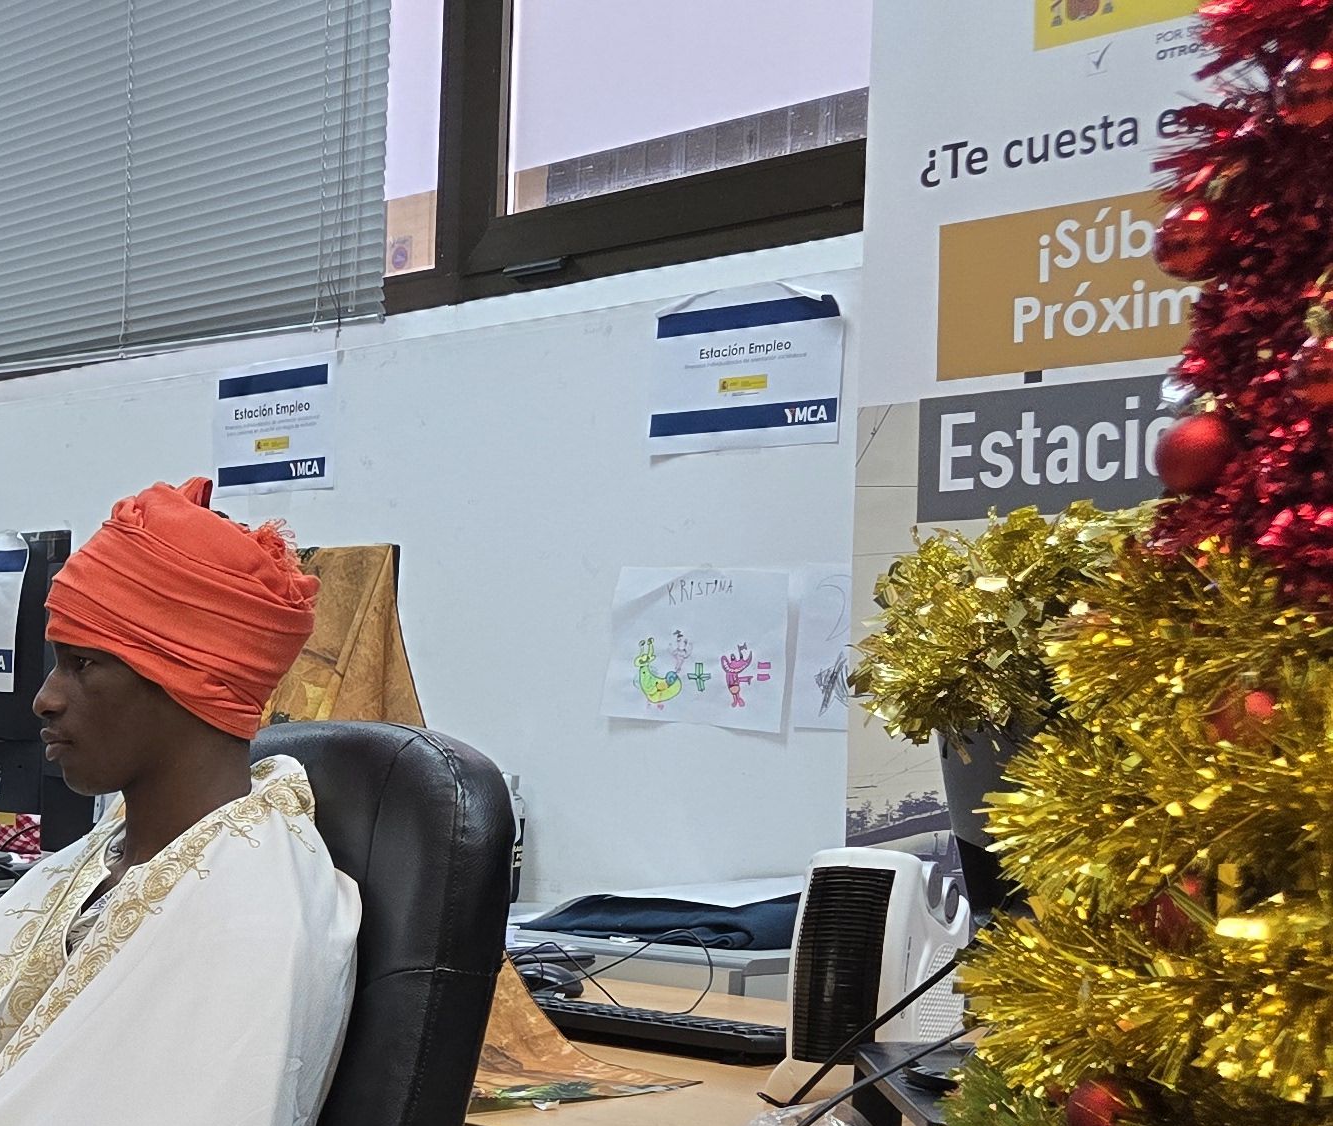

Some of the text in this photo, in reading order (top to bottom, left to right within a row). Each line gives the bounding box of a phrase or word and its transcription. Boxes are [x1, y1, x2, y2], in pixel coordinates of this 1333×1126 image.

[1156, 28, 1183, 44] POR
[1156, 42, 1205, 60] OTRO
[920, 141, 989, 188] ¿Te
[1003, 115, 1138, 169] cuesta
[1038, 207, 1156, 283] ¡Súb
[1013, 280, 1202, 344] Próxim
[699, 339, 792, 359] Estación Empleo
[234, 401, 310, 420] Estación Empleo
[784, 405, 827, 423] YMCA
[938, 395, 1179, 493] Estació
[289, 460, 320, 477] YMCA
